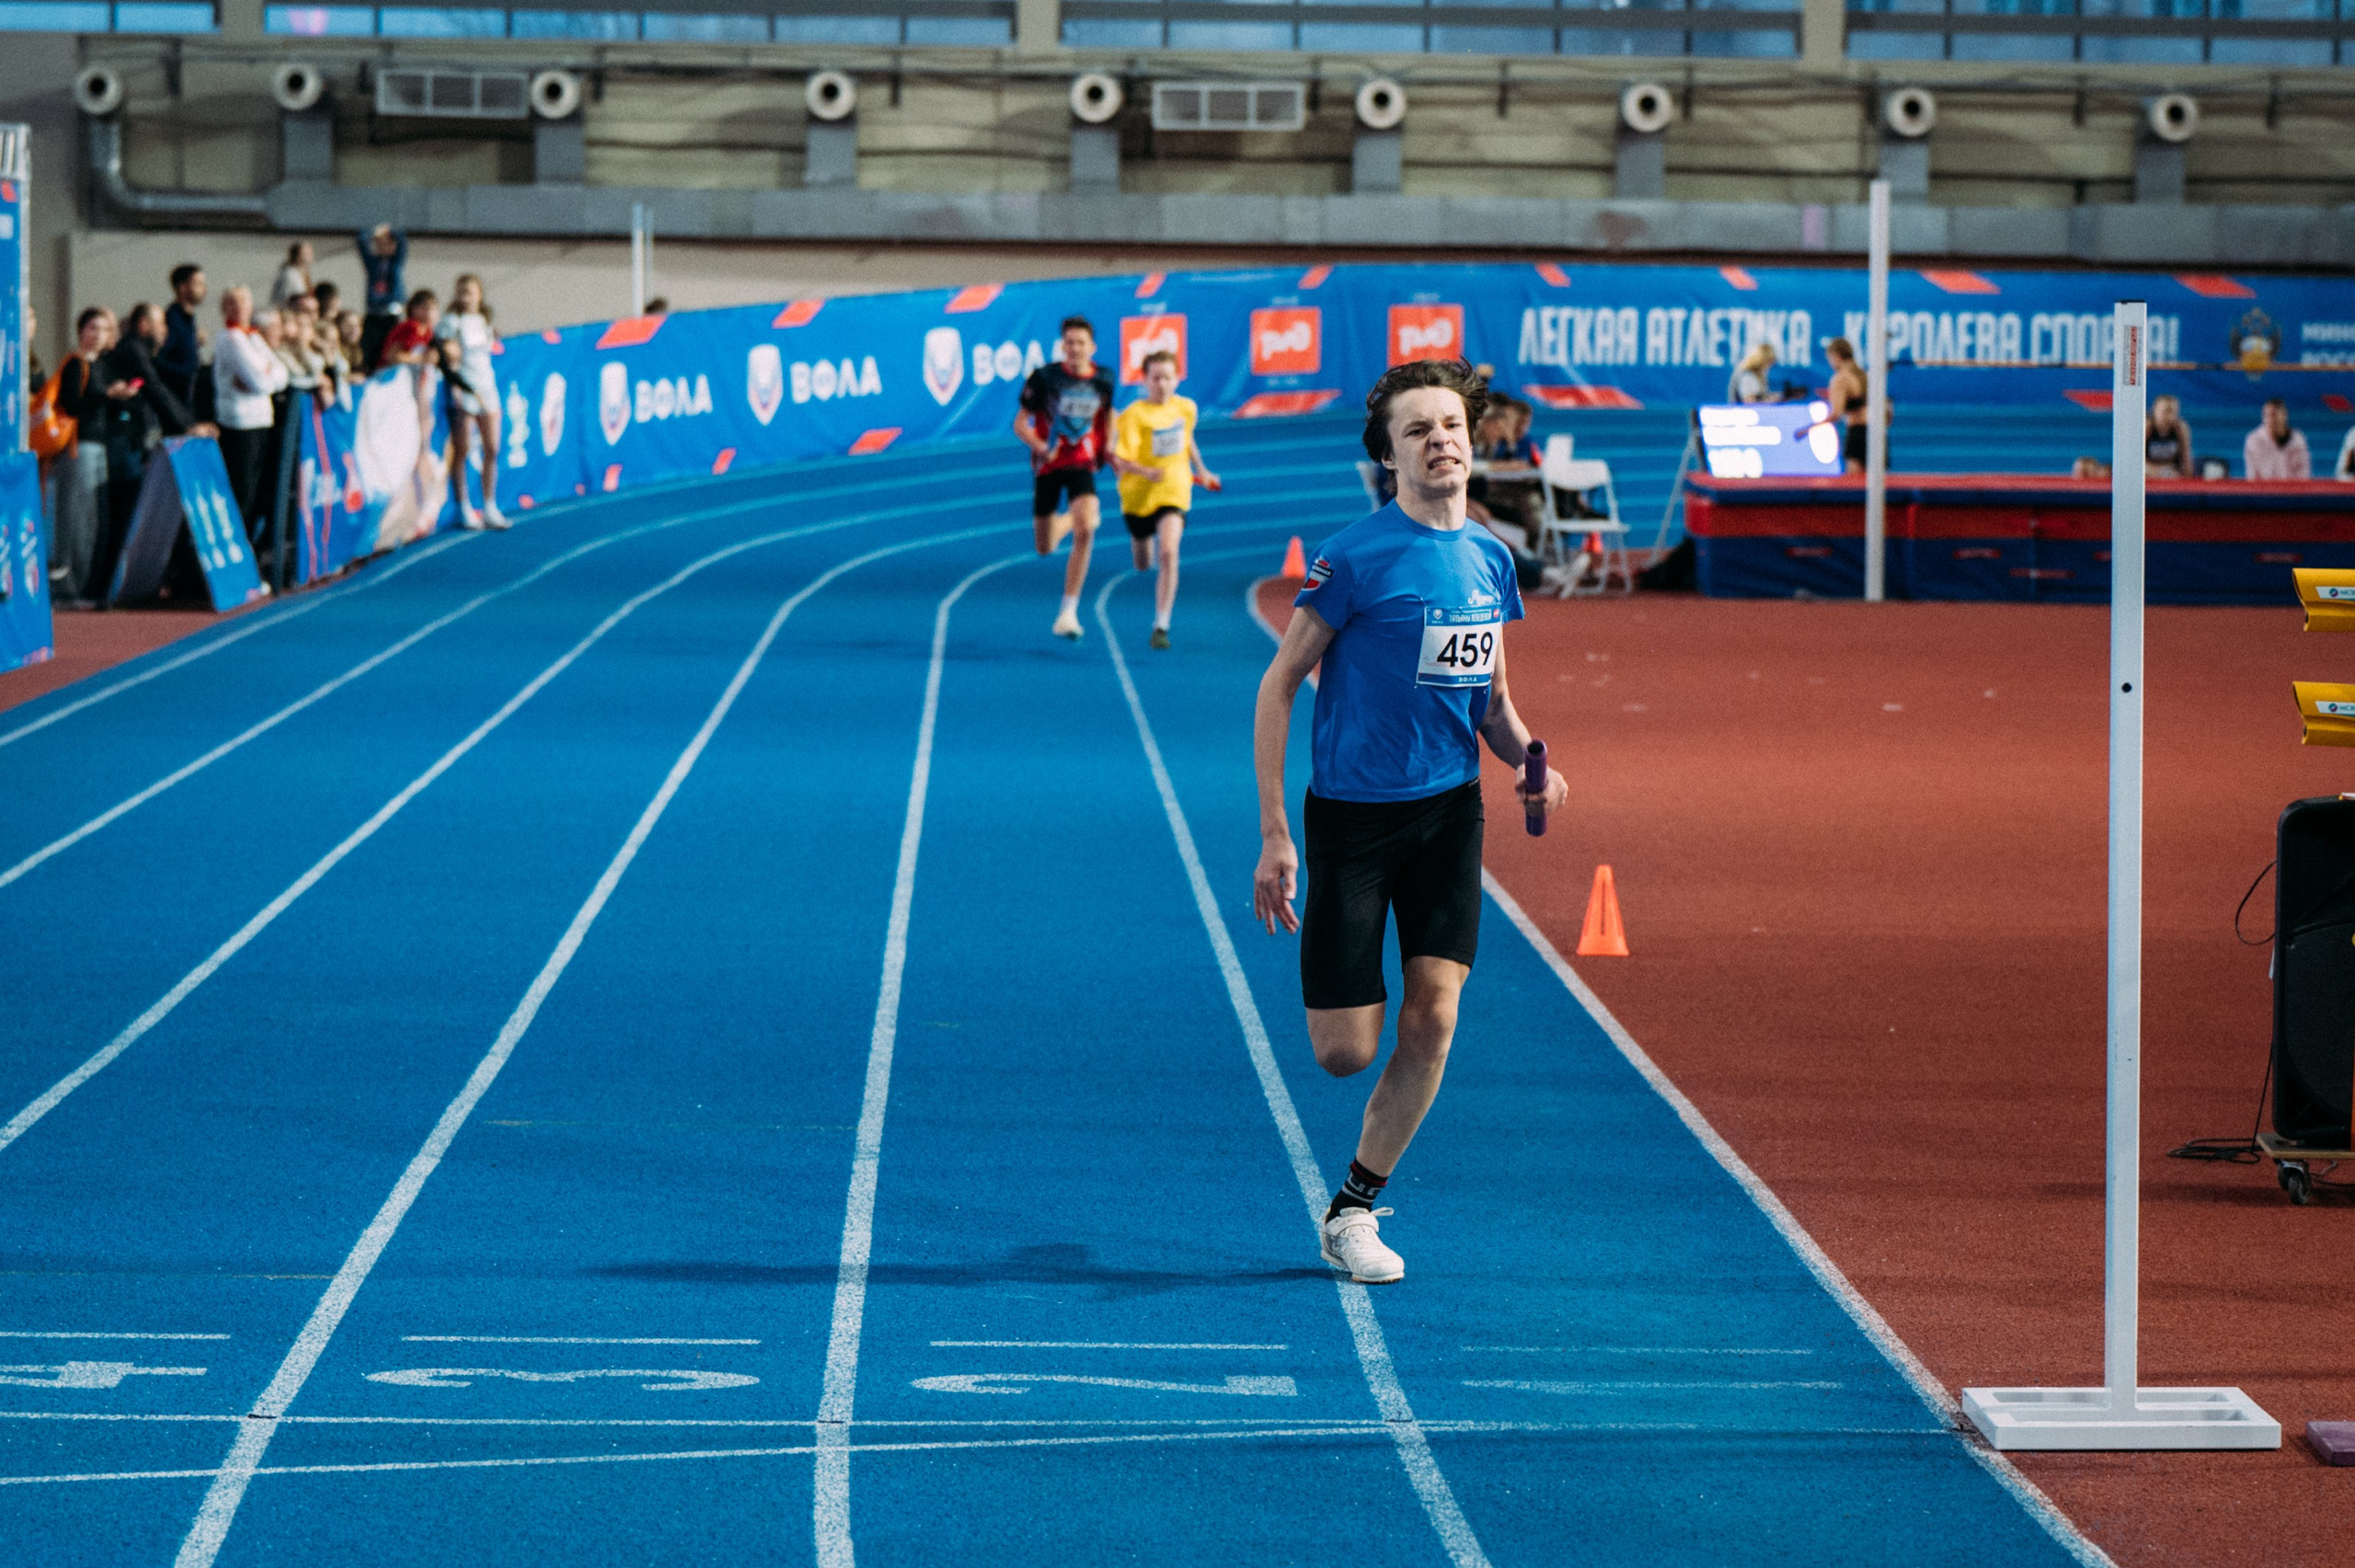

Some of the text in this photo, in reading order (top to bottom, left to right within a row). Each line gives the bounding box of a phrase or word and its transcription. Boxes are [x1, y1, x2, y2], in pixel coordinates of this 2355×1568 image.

[1518, 306, 1638, 365] ЛЕГКАЯ
[1645, 307, 1812, 366] АТЛЕТИКА
[1844, 311, 2021, 367] КРОЛЕВА
[2030, 313, 2179, 364] СПОРА!
[1437, 632, 1493, 668] 459
[365, 1368, 760, 1391] 3
[910, 1372, 1298, 1397] 2
